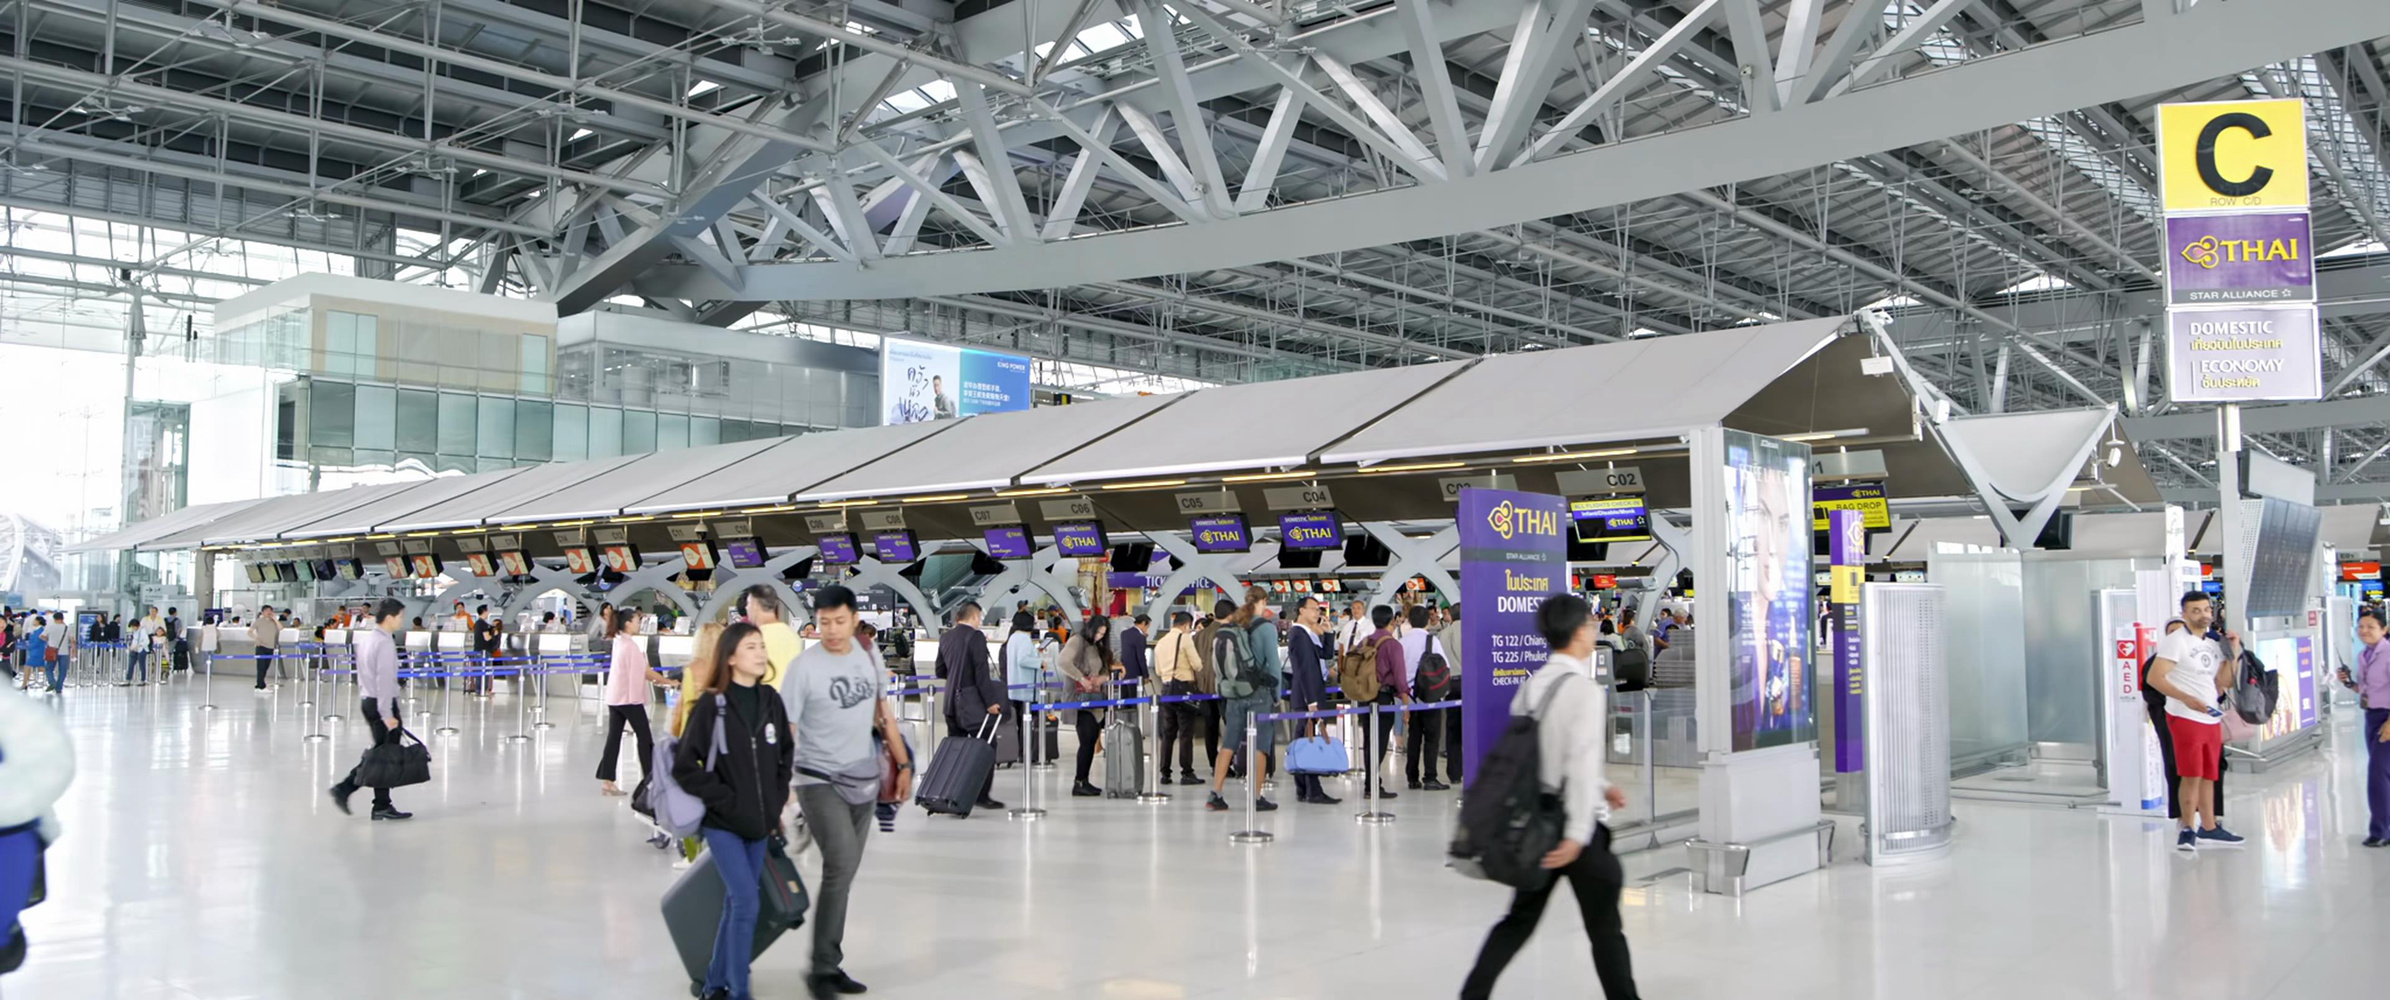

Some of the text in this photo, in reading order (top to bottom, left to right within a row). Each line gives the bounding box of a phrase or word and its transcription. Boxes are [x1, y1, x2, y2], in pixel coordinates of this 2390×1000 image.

[2195, 112, 2274, 197] C
[2210, 196, 2262, 206] ROW C/D
[2219, 237, 2299, 263] THAI
[2189, 289, 2278, 300] STAR ALLIANCE
[2189, 320, 2273, 336] DOMESTIC
[2201, 358, 2284, 373] ECONOMY
[1606, 473, 1636, 487] C02
[1181, 497, 1203, 508] C05
[1303, 491, 1327, 502] C04
[1071, 503, 1090, 514] C06
[1836, 503, 1855, 511] BAG
[974, 510, 990, 520] C07
[1514, 507, 1557, 536] THAI
[1615, 518, 1634, 526] THAI
[1212, 530, 1240, 542] THAI
[1302, 527, 1332, 539] THAI
[1072, 536, 1097, 547] THAI
[1506, 552, 1519, 560] STAR
[1505, 569, 1549, 591] ในประเทศ
[1491, 634, 1503, 647] TG
[1505, 635, 1519, 646] 122
[1524, 634, 1547, 648] Chiang
[1491, 651, 1503, 663] TG
[1505, 651, 1519, 662] 225
[1524, 650, 1548, 662] Phuket
[1492, 676, 1519, 686] CHECK-IN
[2122, 661, 2132, 694] AED
